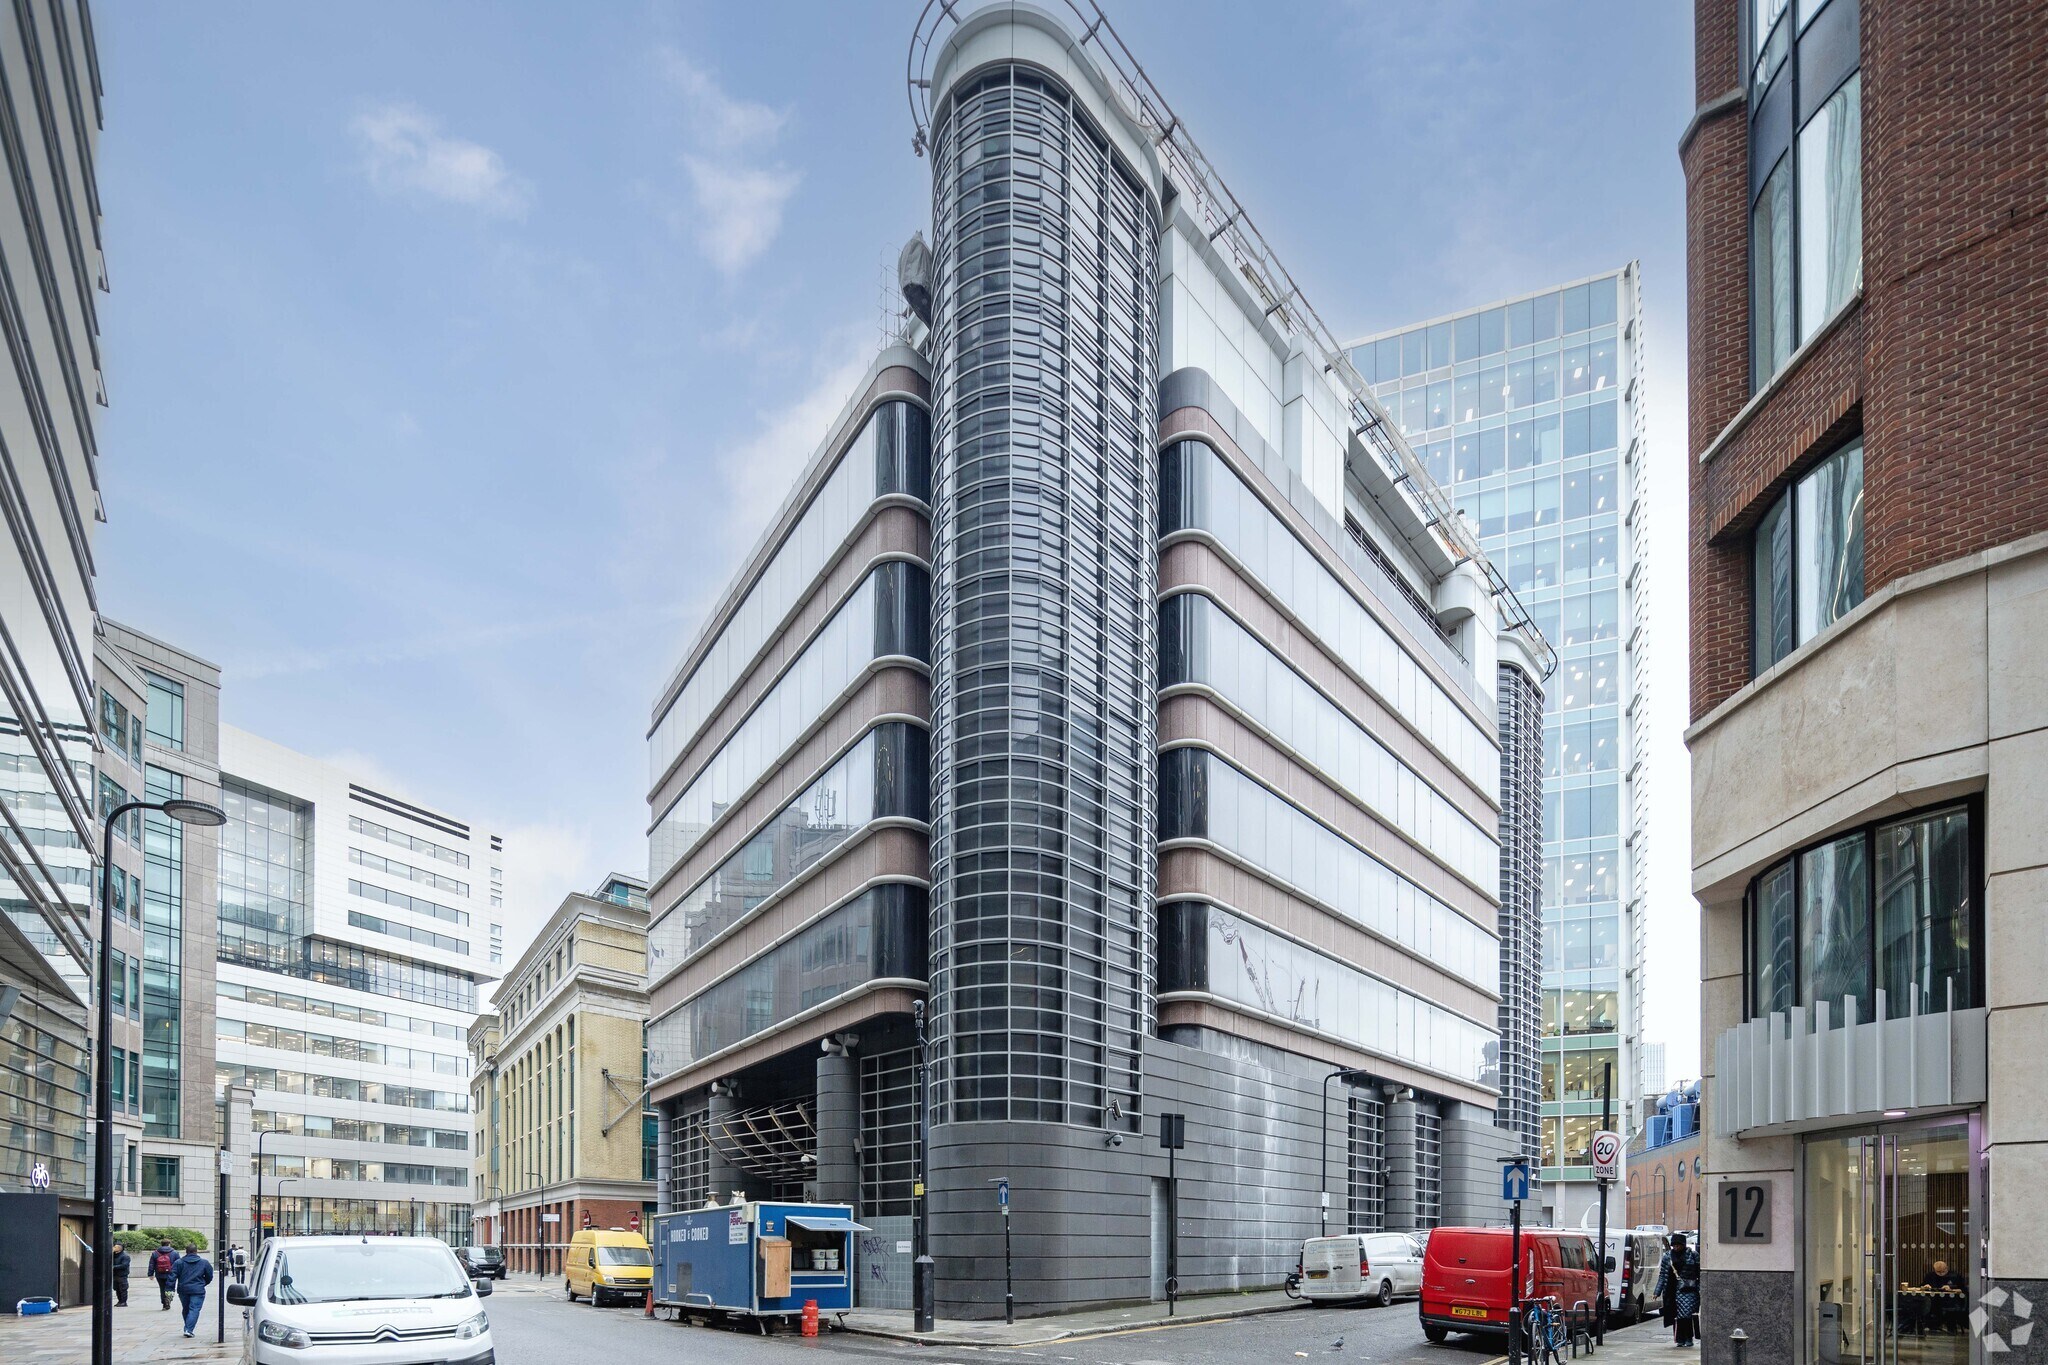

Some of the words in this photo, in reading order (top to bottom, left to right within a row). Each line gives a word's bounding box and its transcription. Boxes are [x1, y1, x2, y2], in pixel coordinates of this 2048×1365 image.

[1597, 1142, 1614, 1155] 20
[1596, 1165, 1614, 1175] ZONE
[1725, 1186, 1764, 1237] 12
[670, 1229, 686, 1242] HOOKED
[691, 1226, 709, 1241] COOKED
